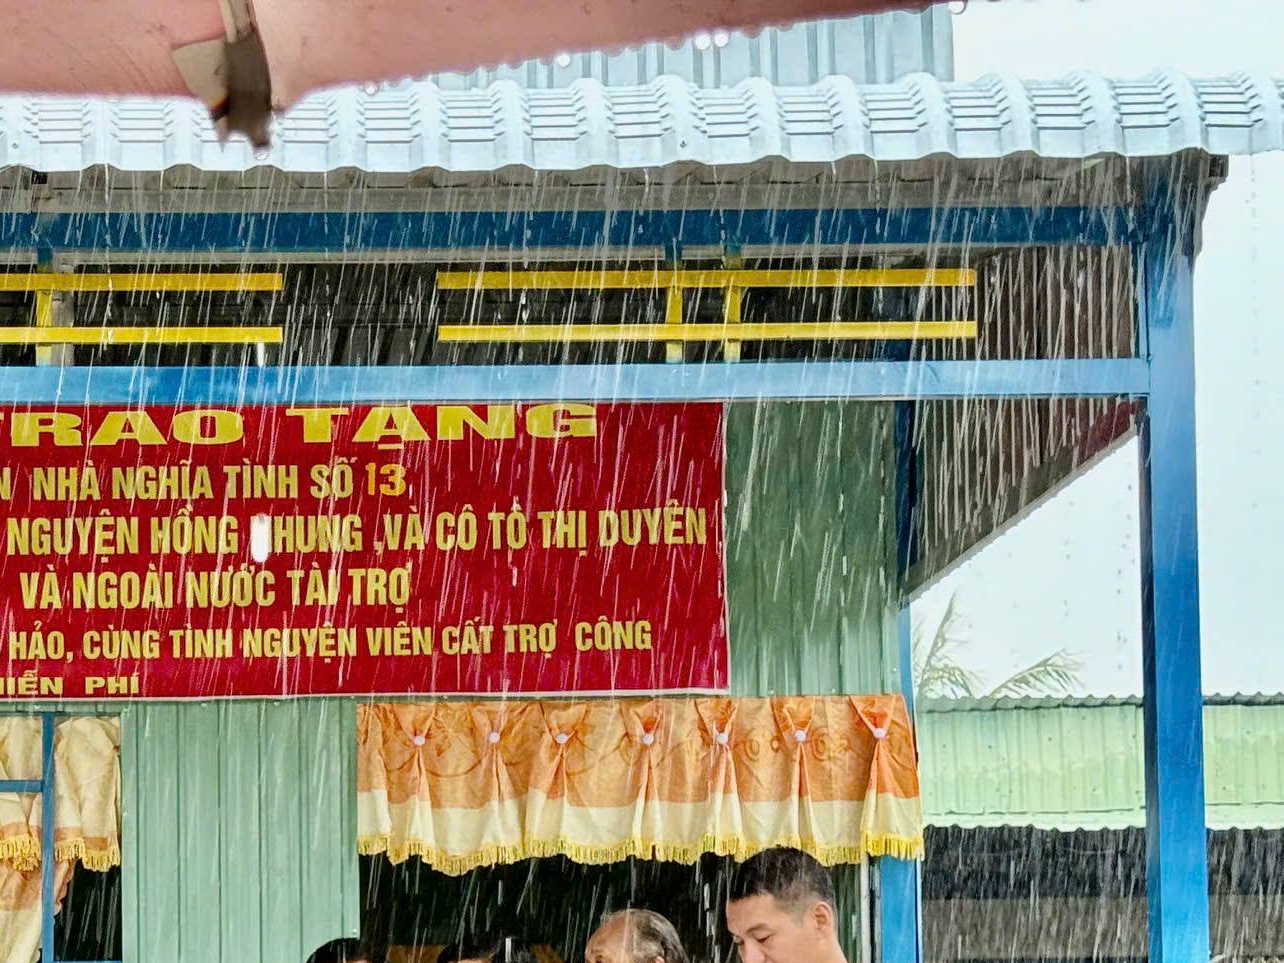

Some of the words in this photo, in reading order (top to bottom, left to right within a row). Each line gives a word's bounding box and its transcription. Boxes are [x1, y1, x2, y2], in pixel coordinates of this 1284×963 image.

[32, 459, 102, 501] NHÀ
[111, 458, 214, 500] NGHĨA
[222, 457, 299, 499] TÌNH
[310, 456, 359, 499] SỐ
[364, 462, 406, 497] 13
[6, 508, 139, 564] NGUYỆN
[149, 503, 239, 555] HỒNG
[435, 503, 478, 551] CÔ
[536, 510, 588, 557] THỊ
[598, 498, 707, 548] DUYÊN
[19, 563, 63, 610] VÀ
[72, 562, 174, 610] NGOÀI
[185, 562, 276, 609] NƯỚC
[286, 562, 339, 607] TÀI
[347, 559, 412, 614] TRỢ
[11, 620, 74, 664] HẢO,
[82, 624, 161, 660] CÙNG
[168, 622, 234, 659] TÌNH
[242, 620, 358, 664] NGUYỆN
[365, 620, 433, 657] VIÊN
[441, 615, 494, 656] CẤT
[502, 617, 559, 659] TRỢ
[574, 615, 653, 652] CÔNG
[84, 672, 140, 695] PHÍ
